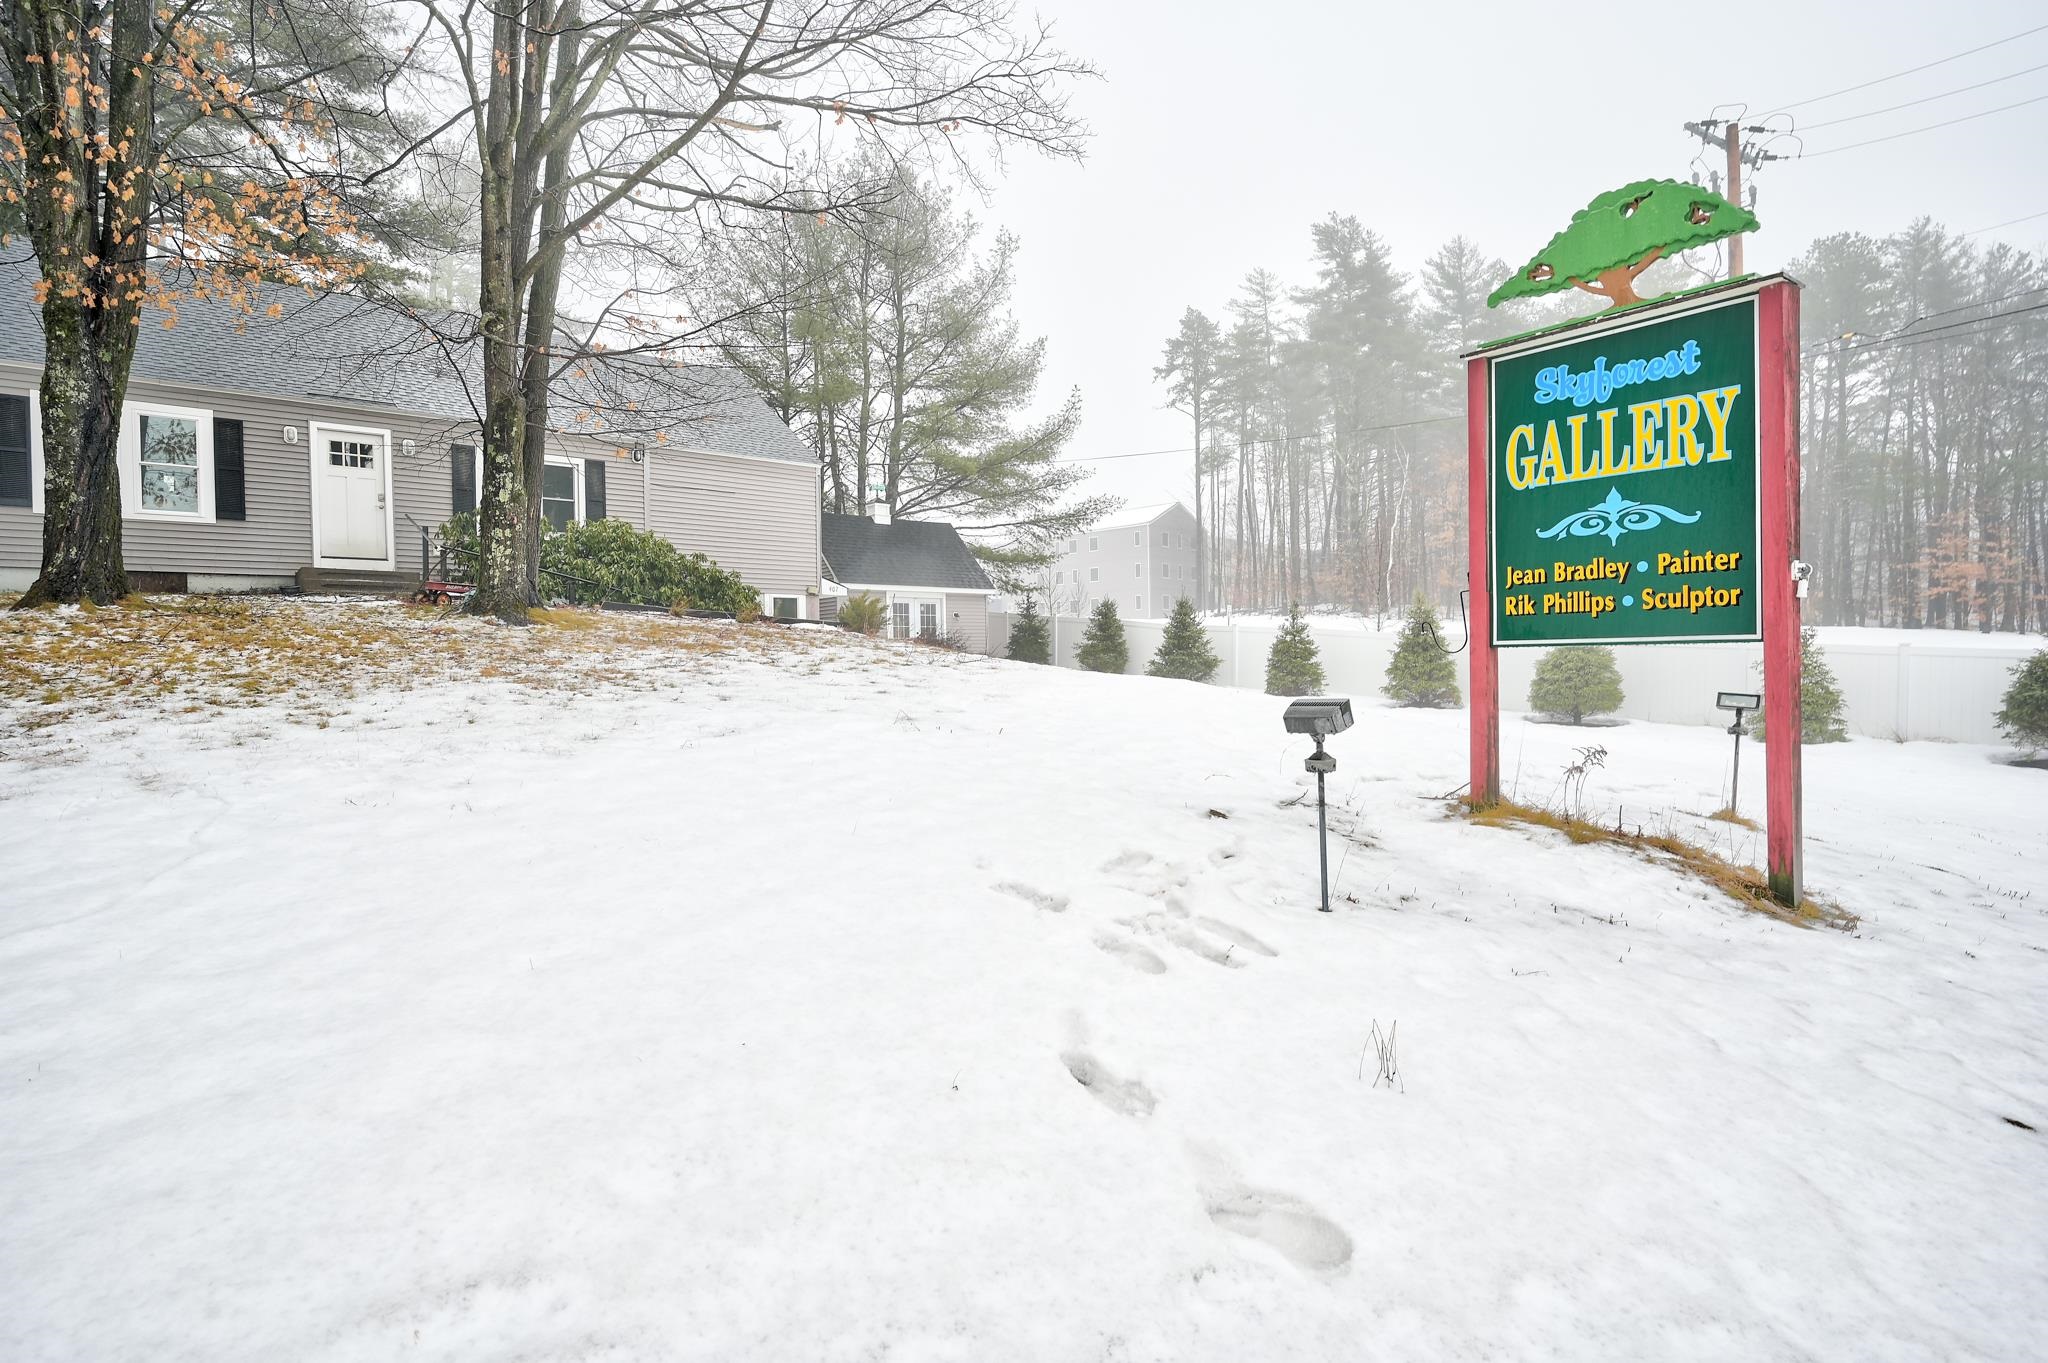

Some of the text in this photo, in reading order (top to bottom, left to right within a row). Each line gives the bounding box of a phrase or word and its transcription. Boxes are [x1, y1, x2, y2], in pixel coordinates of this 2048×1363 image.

[1534, 340, 1701, 407] Skyforest
[1506, 384, 1741, 491] GALLERY
[1505, 550, 1741, 589] Jean Bradley Painter
[1505, 585, 1742, 618] Rik Phillips Sculptor
